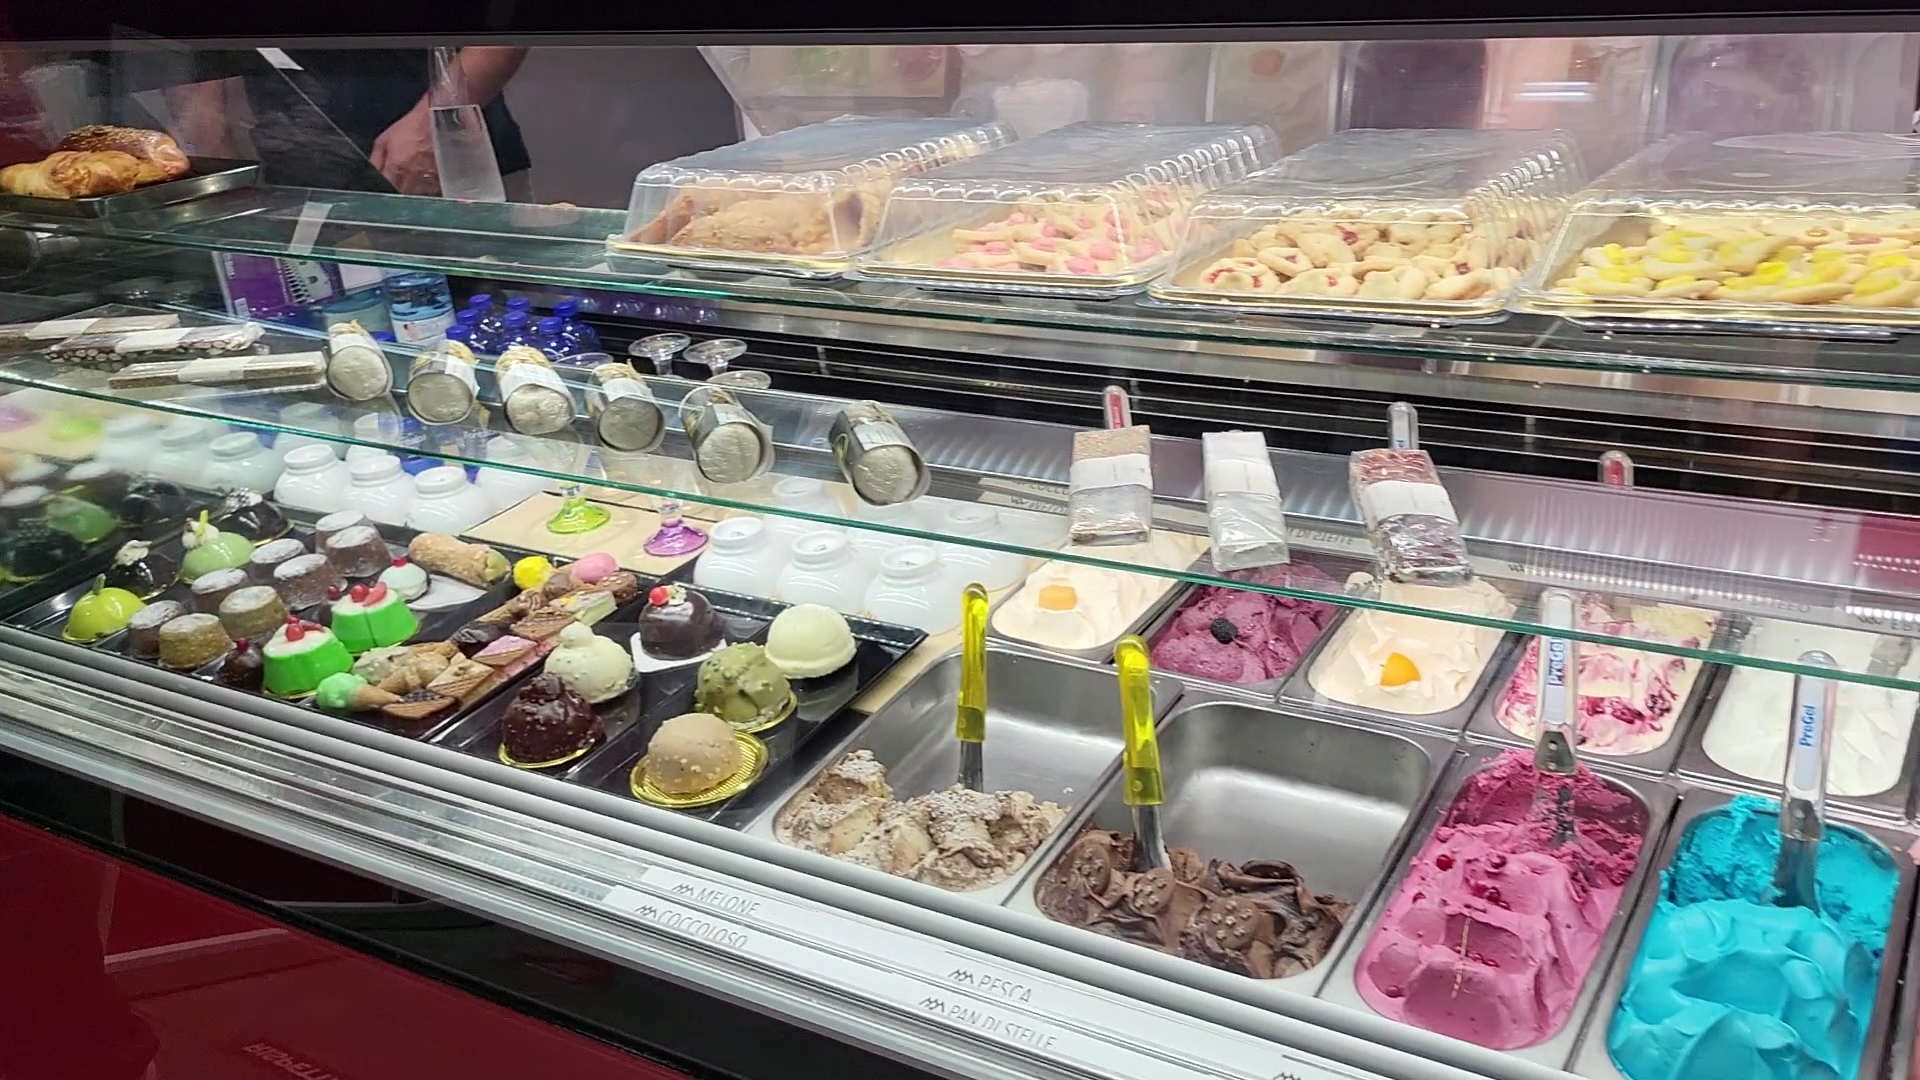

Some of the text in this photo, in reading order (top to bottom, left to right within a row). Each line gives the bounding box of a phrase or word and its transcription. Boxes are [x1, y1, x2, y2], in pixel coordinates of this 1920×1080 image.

[694, 887, 761, 916] MELONE
[657, 909, 748, 949] COCCOLOSO
[977, 974, 1034, 1003] PESCA
[949, 1004, 1058, 1049] PAN DI STELLE
